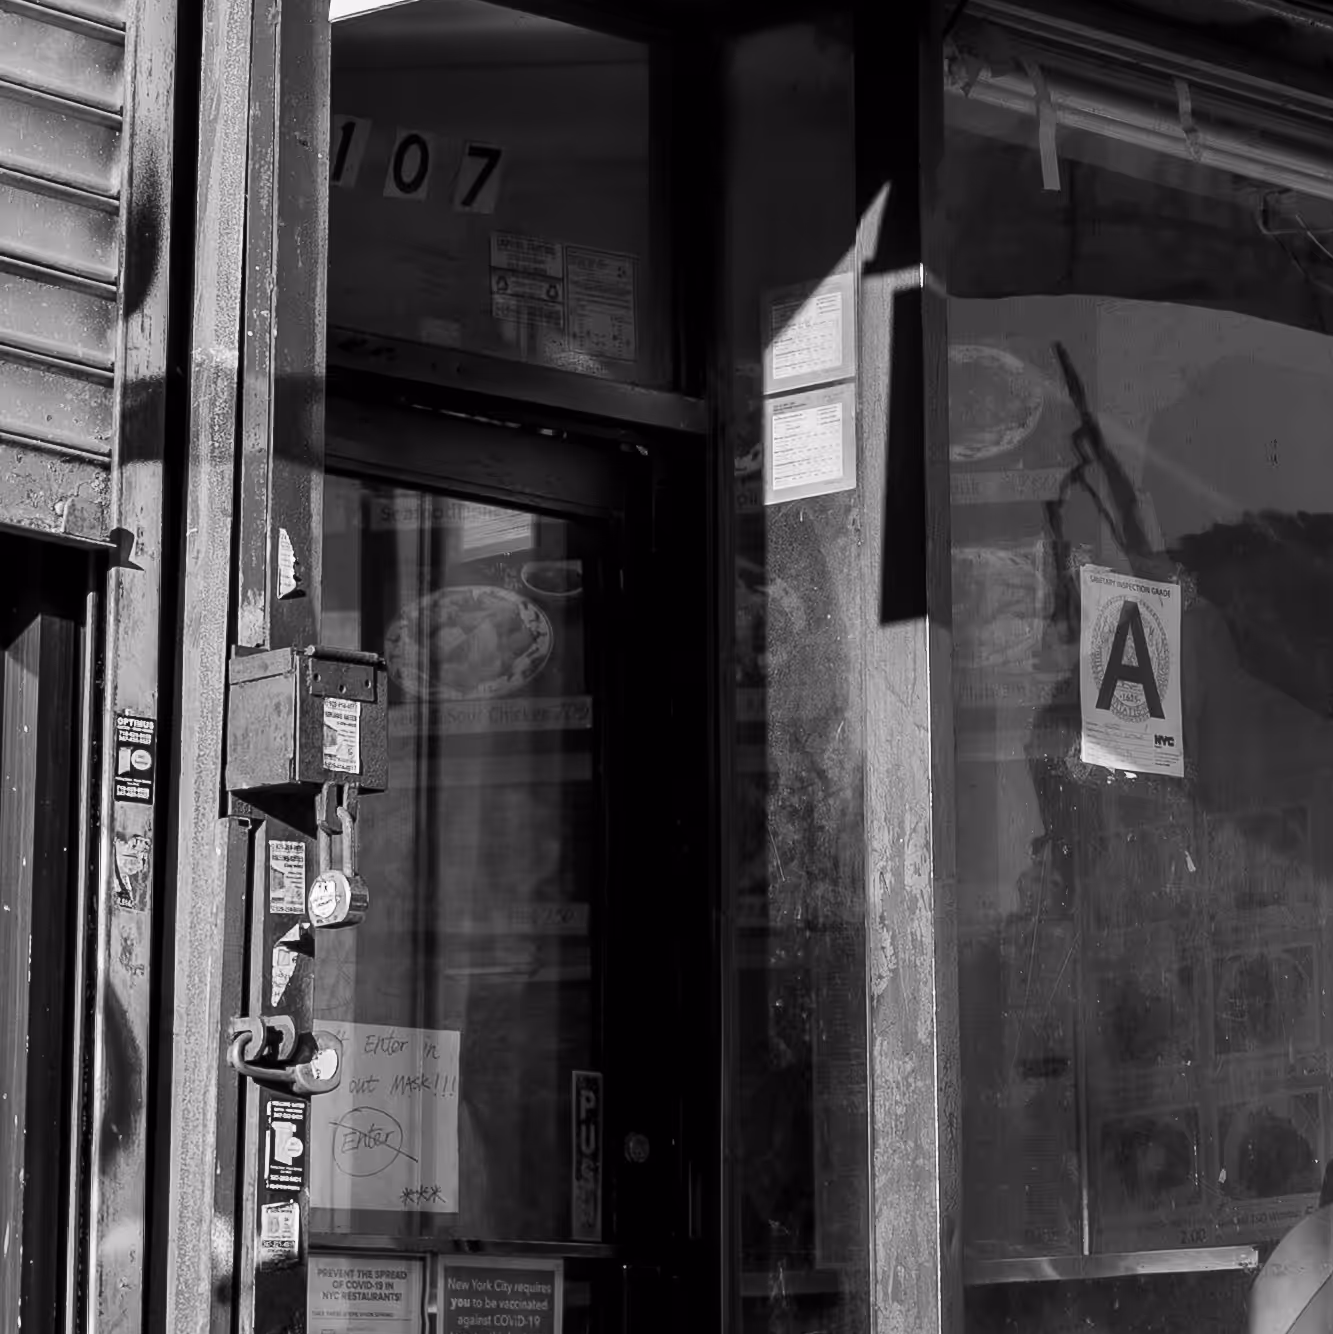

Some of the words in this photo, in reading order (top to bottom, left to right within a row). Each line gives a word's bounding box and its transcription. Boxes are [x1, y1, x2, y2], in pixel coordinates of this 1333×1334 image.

[1116, 580, 1151, 595] INSPECTION
[1151, 586, 1172, 599] GRADE
[1095, 600, 1166, 720] A
[1153, 733, 1175, 747] NYC
[363, 1028, 409, 1057] Enter
[317, 1268, 355, 1279] PREVENT
[357, 1269, 373, 1280] THE
[375, 1270, 408, 1280] SPREAD
[332, 1280, 345, 1289] OF
[345, 1280, 384, 1290] COVID-19
[385, 1281, 394, 1291] IN
[447, 1277, 470, 1290] New
[471, 1278, 492, 1291] York
[494, 1279, 513, 1295] City
[514, 1282, 552, 1296] requires
[321, 1291, 340, 1300] NYC
[450, 1297, 471, 1310] you
[472, 1298, 483, 1308] to
[484, 1296, 497, 1308] be
[499, 1298, 549, 1310] vaccinated
[457, 1314, 492, 1328] against
[493, 1314, 541, 1327] COVID-19
